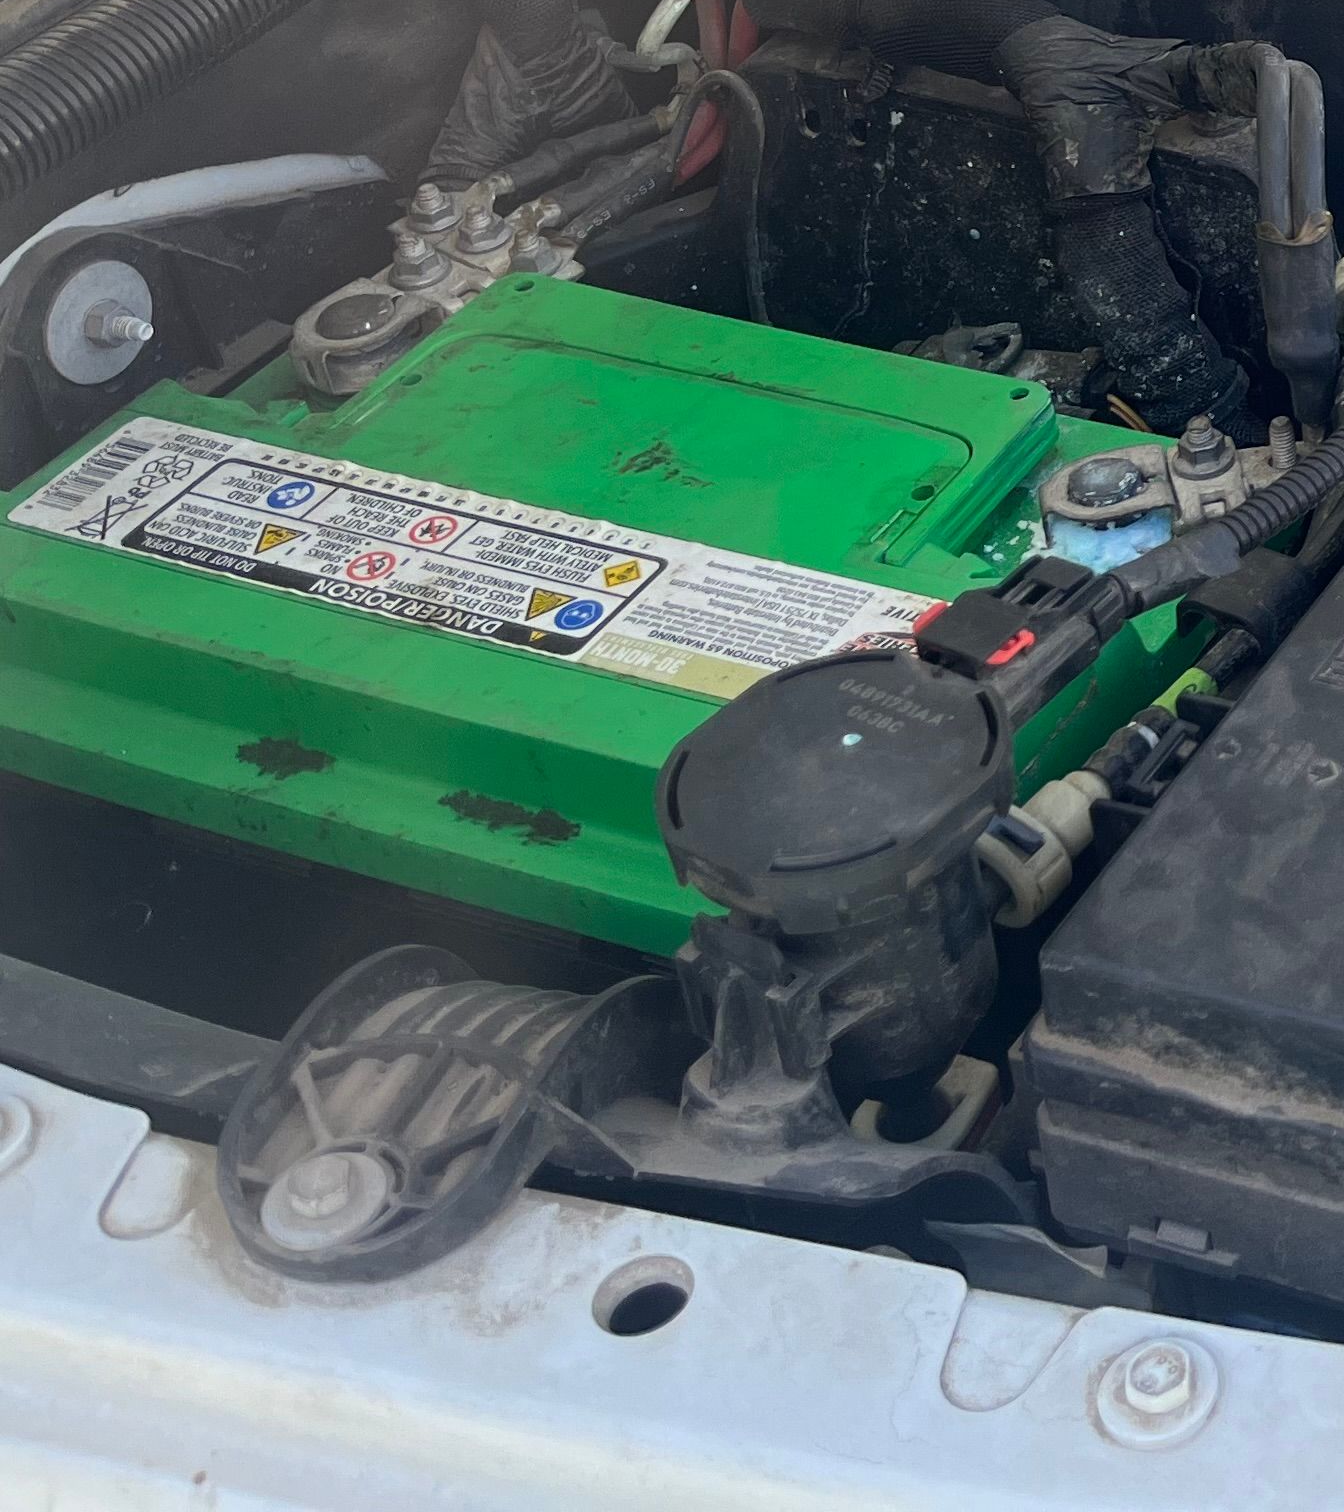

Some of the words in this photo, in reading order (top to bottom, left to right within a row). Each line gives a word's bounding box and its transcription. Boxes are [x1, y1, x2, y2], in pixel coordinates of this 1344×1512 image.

[156, 440, 189, 453] MUST
[172, 432, 222, 449] RECYCLED
[214, 442, 234, 452] BE
[182, 446, 226, 462] BATTERY
[218, 474, 273, 494] INSTRUC-
[122, 485, 152, 499] Pb
[224, 489, 260, 504] READ
[342, 492, 407, 514] CHILDREN.
[208, 510, 249, 525] SEVERE
[325, 513, 347, 524] OF
[346, 505, 389, 522] REACH
[402, 506, 424, 518] OF
[144, 519, 173, 533] CAN
[170, 513, 228, 533] BLINDNESS
[243, 518, 264, 529] OR
[342, 517, 371, 530] OUT
[384, 514, 413, 527] THE
[165, 524, 199, 539] ACID
[222, 526, 259, 540] CAUSE
[314, 527, 367, 545] SMOKING
[366, 522, 400, 537] KEEP
[135, 535, 178, 552] OPEN.
[193, 531, 254, 553] SULFURIC
[314, 538, 356, 554] FLAMES
[470, 535, 496, 547] GET
[491, 539, 539, 558] WATER.
[528, 536, 561, 550] HELP
[170, 543, 196, 556] OR
[188, 548, 214, 561] TIP
[304, 547, 345, 563] SPARKS
[471, 547, 525, 567] IMMEDI-
[535, 550, 567, 564] WITH
[557, 542, 613, 562] MEDICAL
[208, 553, 237, 567] NOT
[232, 559, 258, 572] DO
[521, 559, 553, 574] EYES
[564, 557, 602, 573] ATELY
[319, 562, 343, 574] NO
[456, 569, 476, 580] OR
[551, 566, 591, 583] FLUSH
[384, 578, 450, 601] EXPLOSIVE
[430, 576, 466, 591] CAUSE
[462, 583, 488, 596] CAN
[473, 573, 531, 593] BLINDNESS
[445, 593, 480, 609] EYES.
[486, 589, 526, 606] GASES
[308, 577, 503, 635] DANGER/POISON
[477, 601, 523, 619] SHIELD
[647, 628, 707, 649] WARNING
[706, 643, 723, 653] 65
[588, 639, 687, 675] 30-MONTH
